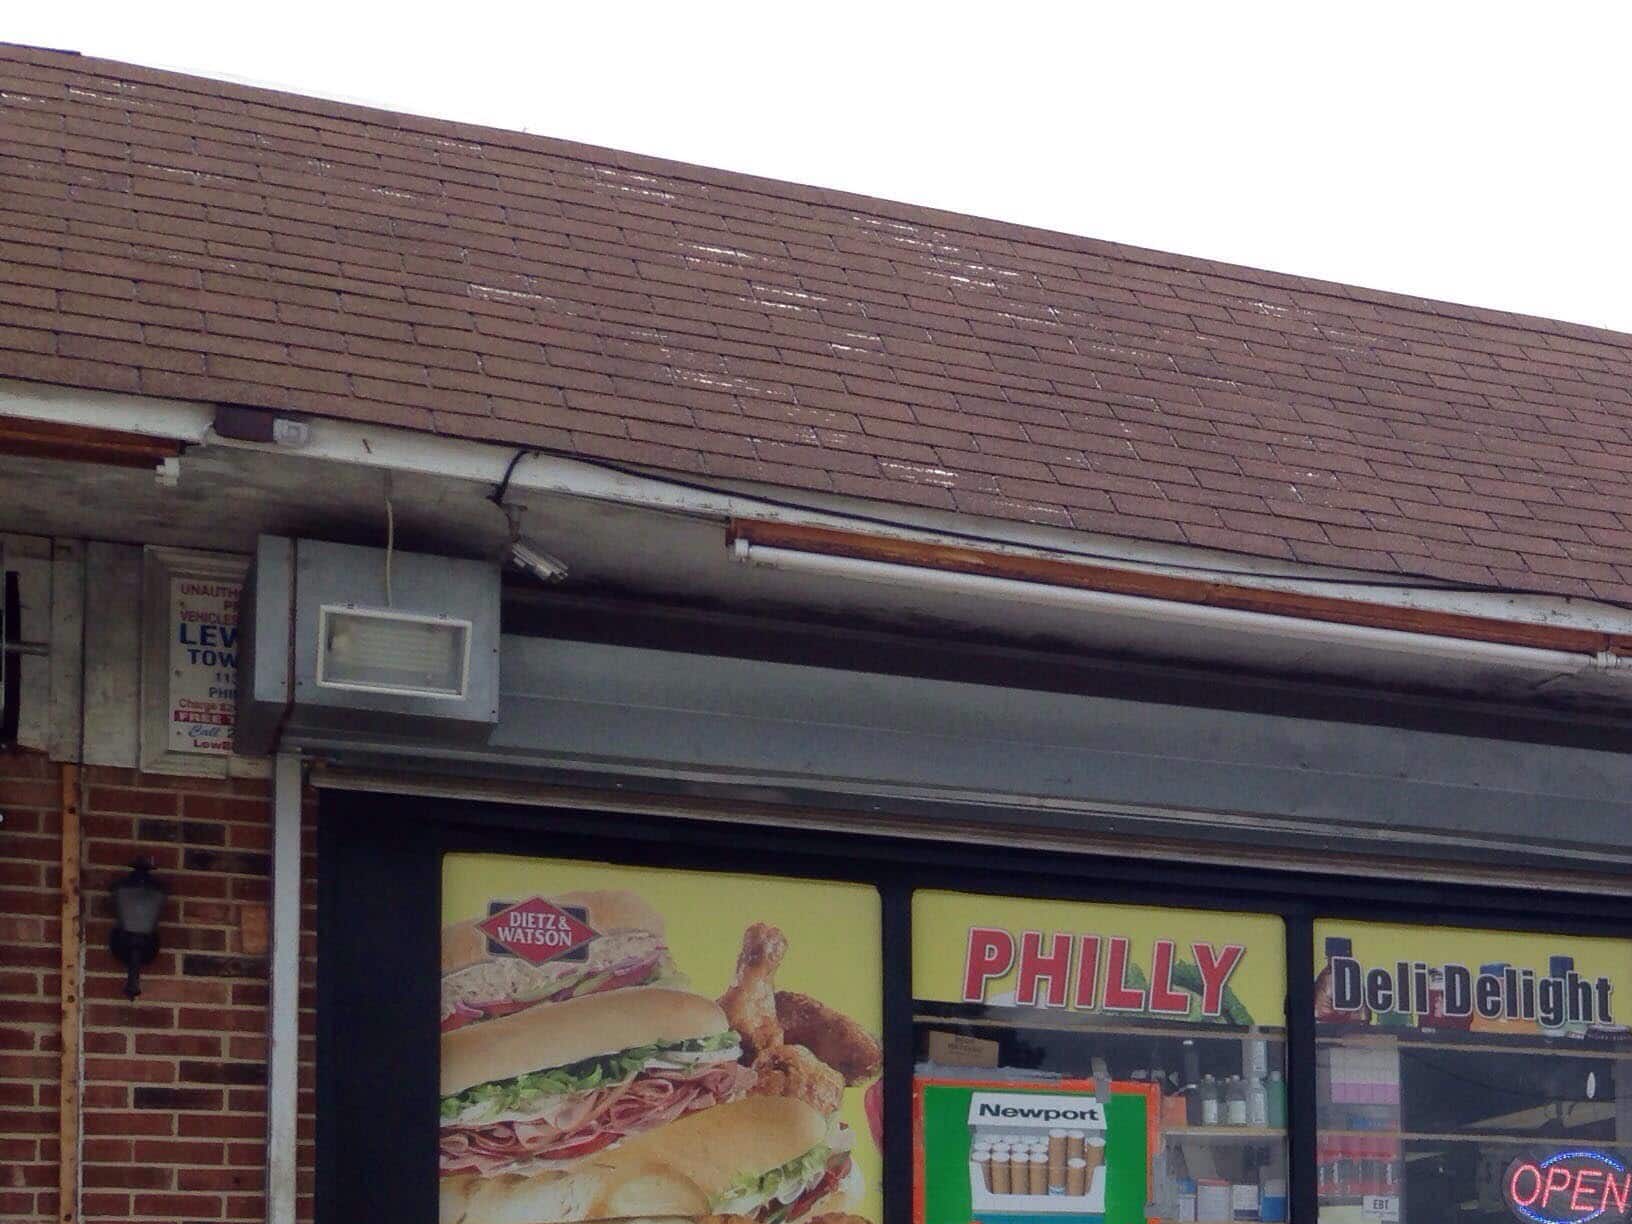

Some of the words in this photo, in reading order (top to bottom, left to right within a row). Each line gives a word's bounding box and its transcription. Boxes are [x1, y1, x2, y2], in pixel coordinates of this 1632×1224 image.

[181, 583, 242, 598] UNAUTH
[187, 648, 240, 668] TOW
[510, 911, 556, 930] DIETZ
[558, 915, 571, 930] &
[497, 926, 572, 947] WATSON
[962, 926, 1248, 1017] PHILLY
[1331, 956, 1430, 1014] Deli
[1442, 963, 1615, 1029] Delight
[979, 1102, 1100, 1121] Newport
[1511, 1163, 1632, 1215] OPEN
[1372, 1199, 1389, 1210] EBT
